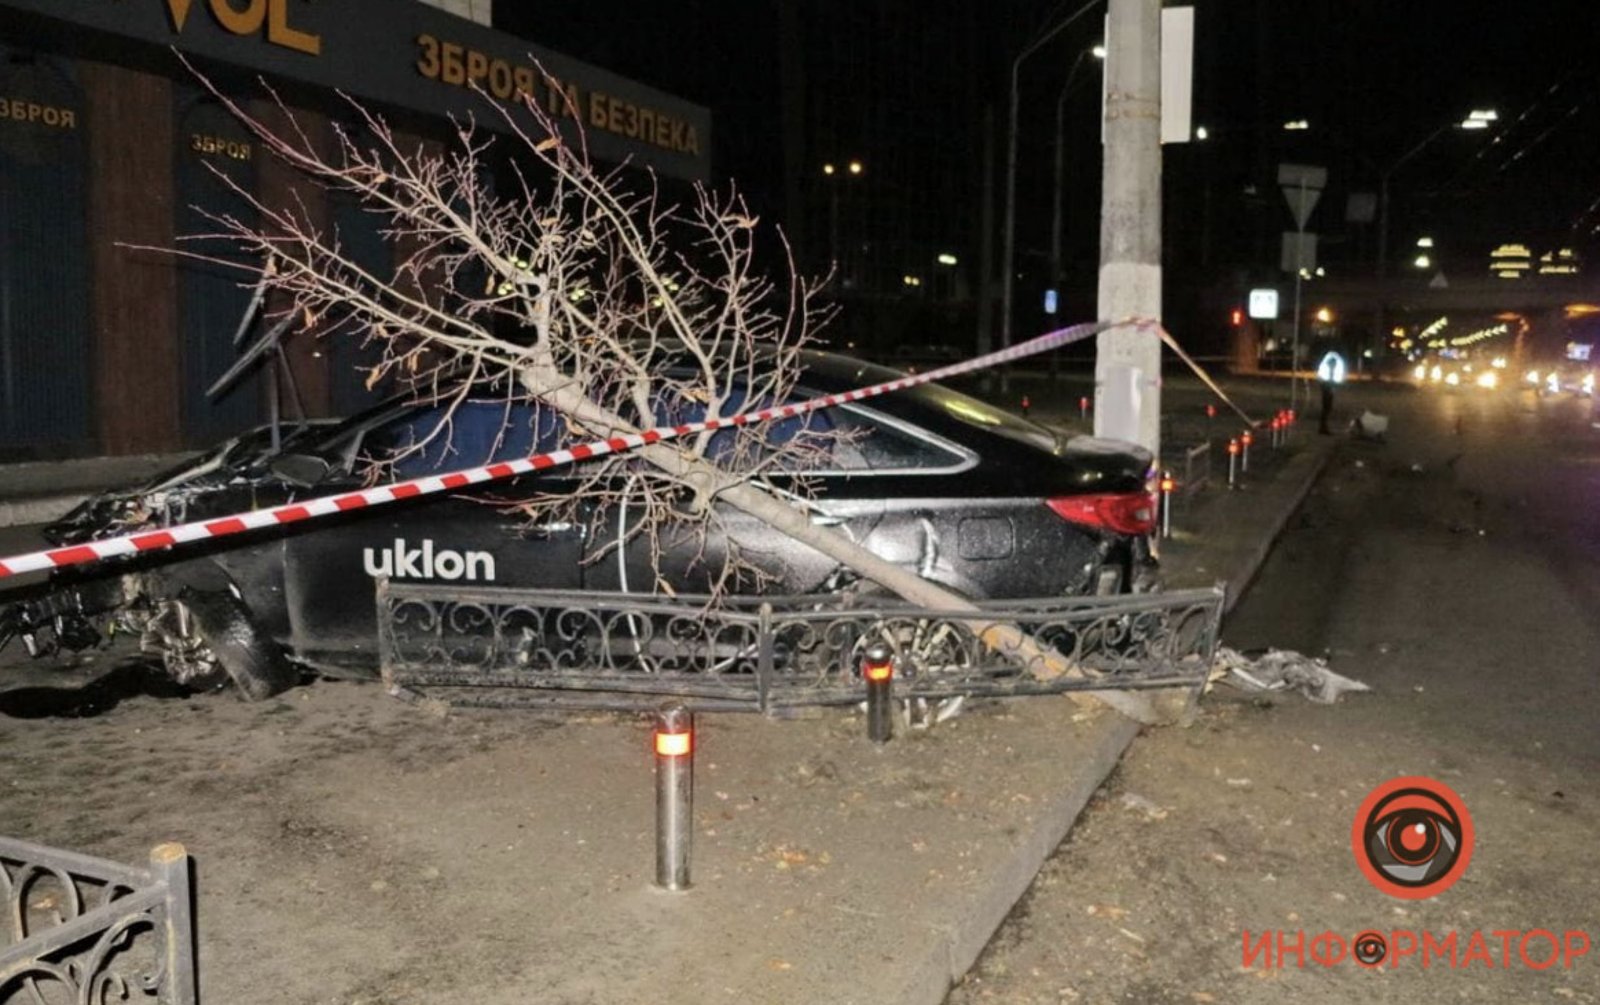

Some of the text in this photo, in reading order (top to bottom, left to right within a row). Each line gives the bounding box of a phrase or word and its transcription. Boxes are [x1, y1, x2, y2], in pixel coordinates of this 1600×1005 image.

[416, 33, 700, 156] ЗБРОЯ ТА БЕЗПЕКА
[0, 99, 76, 129] ЗБРОЯ
[190, 133, 251, 161] ЗБРОЯ
[363, 537, 496, 581] uklon
